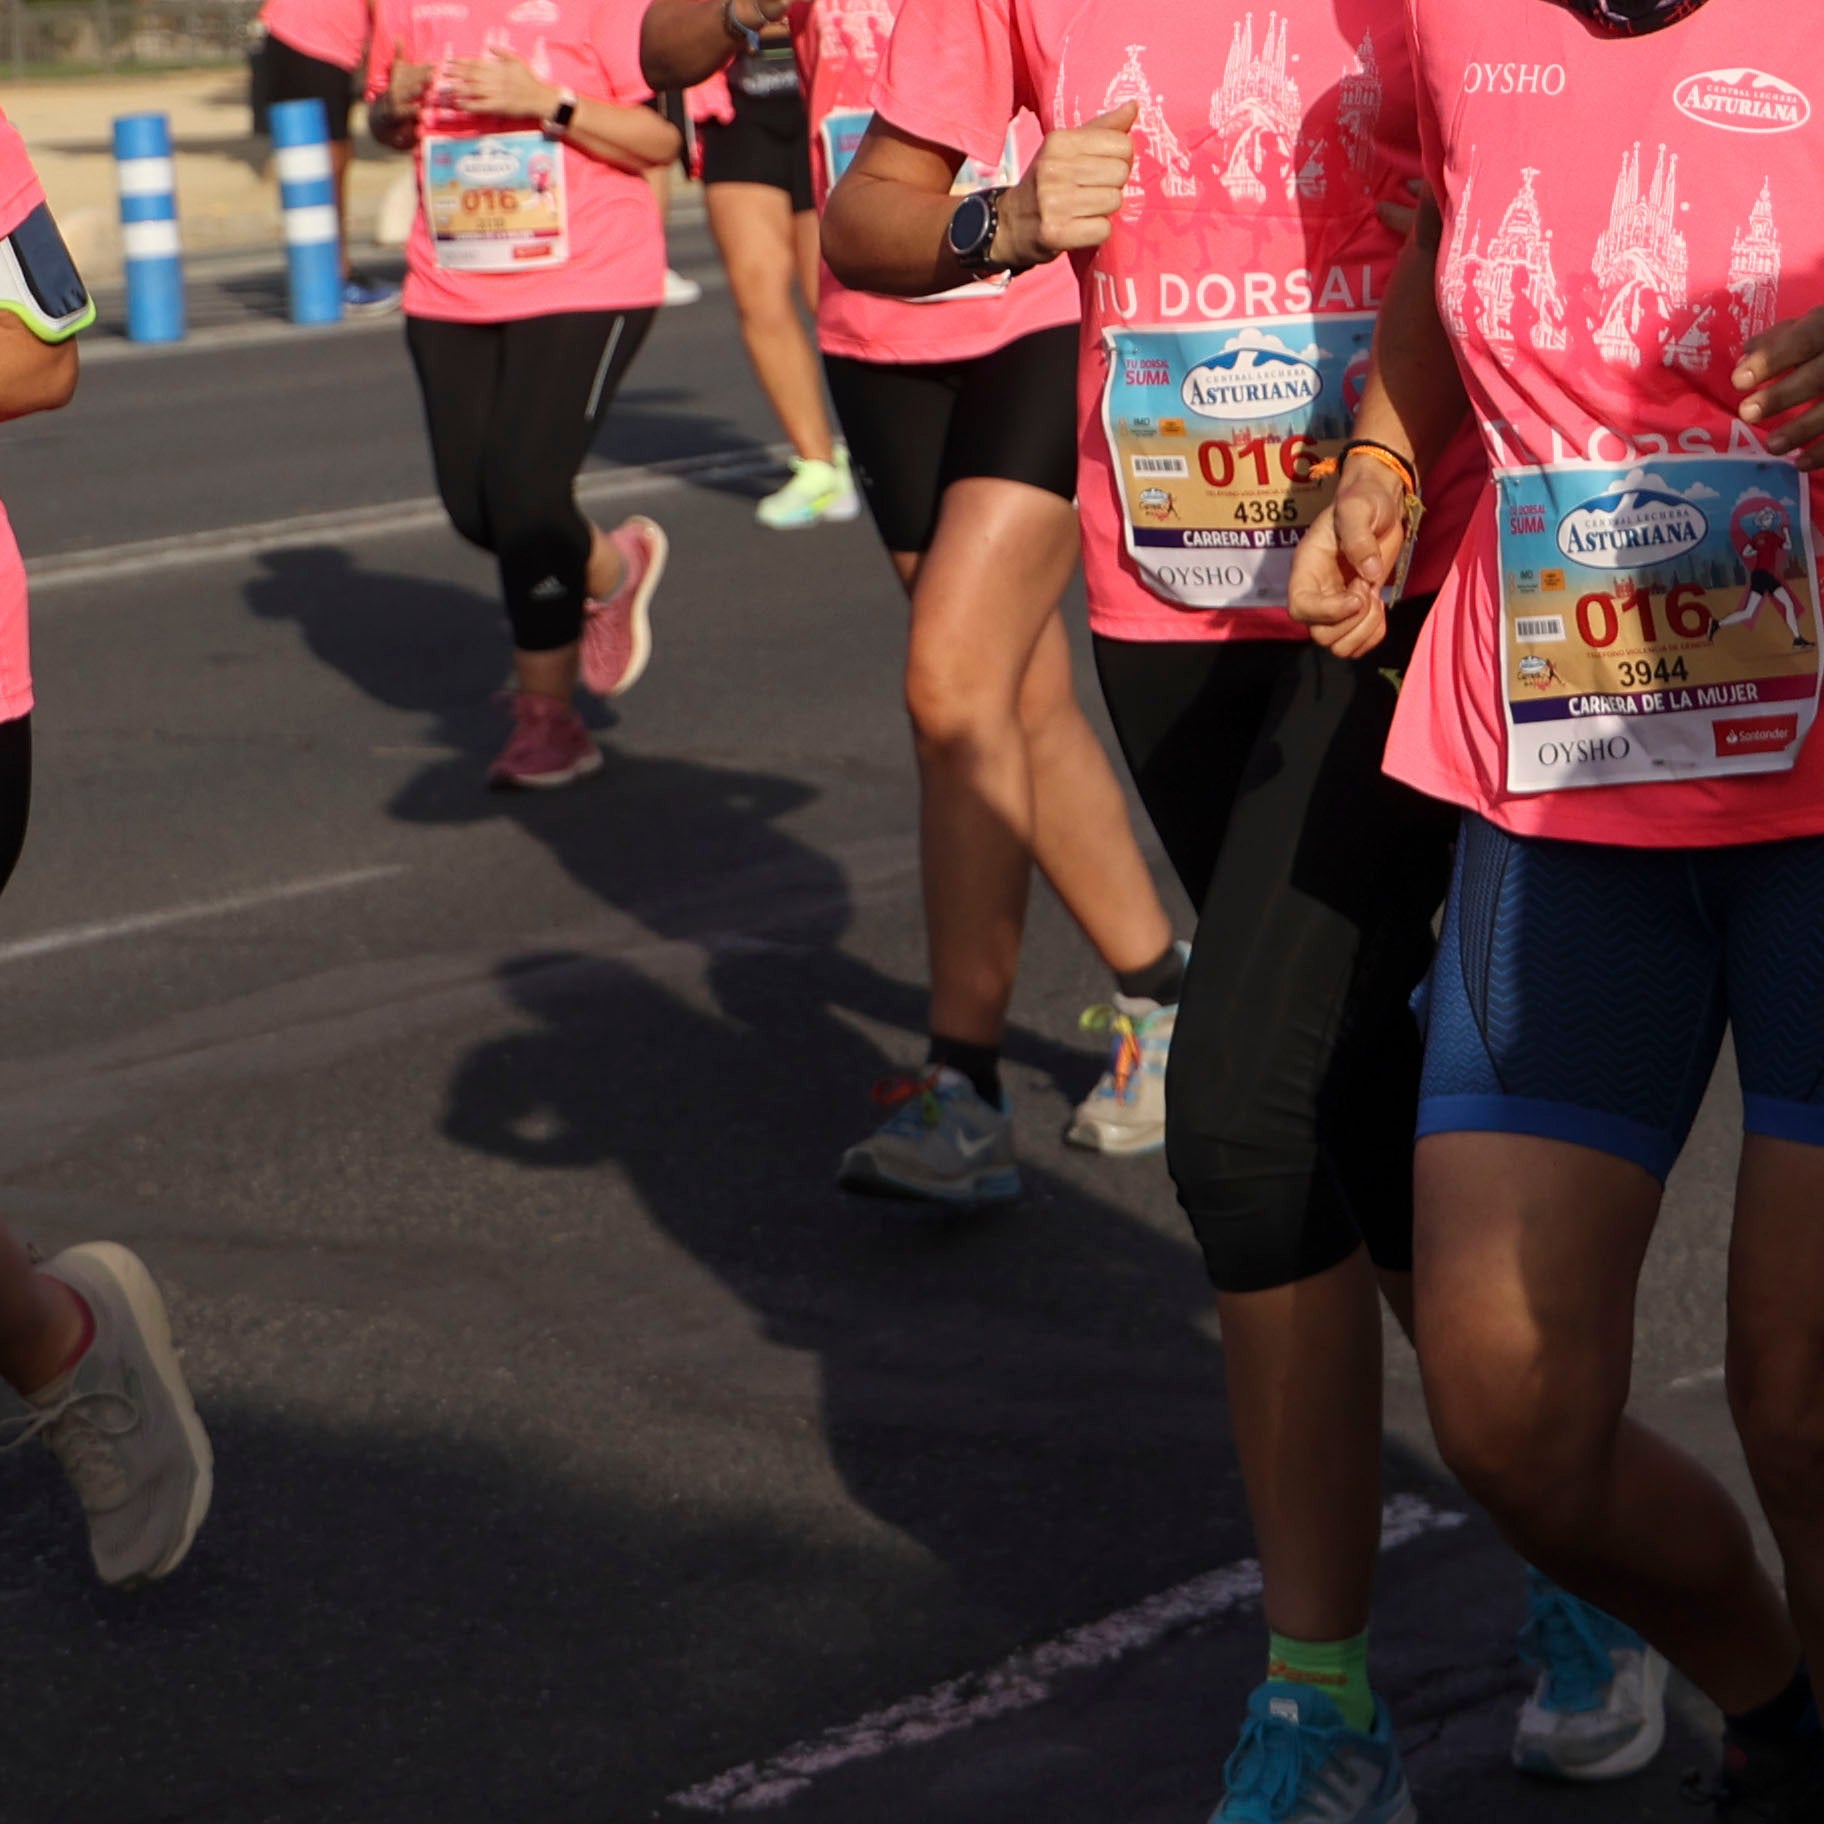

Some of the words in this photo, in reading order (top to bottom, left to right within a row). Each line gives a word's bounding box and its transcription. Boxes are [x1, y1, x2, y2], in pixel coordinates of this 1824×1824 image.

[1463, 62, 1566, 96] OYSHO
[1682, 83, 1799, 122] ASTURIANA
[1094, 270, 1137, 319] TU
[1160, 265, 1384, 318] DORSAL
[1126, 370, 1170, 386] SUMA
[1190, 378, 1313, 405] ASTURIANA
[1198, 434, 1320, 488] 016
[1234, 498, 1298, 524] 4385
[1510, 516, 1546, 535] SUMA
[1182, 530, 1251, 548] CARRERA
[1253, 530, 1274, 546] DE
[1279, 530, 1300, 544] LA
[1567, 519, 1698, 553] ASTURIANA
[1157, 565, 1244, 586] OYSHO
[1575, 582, 1712, 648] 016
[1618, 656, 1689, 687] 3944
[1568, 695, 1637, 717] CARRERA
[1642, 693, 1664, 713] DE
[1668, 688, 1693, 709] LA
[1697, 683, 1759, 706] MUJER
[1538, 735, 1630, 766] OYSHO
[1738, 727, 1790, 743] Santander
